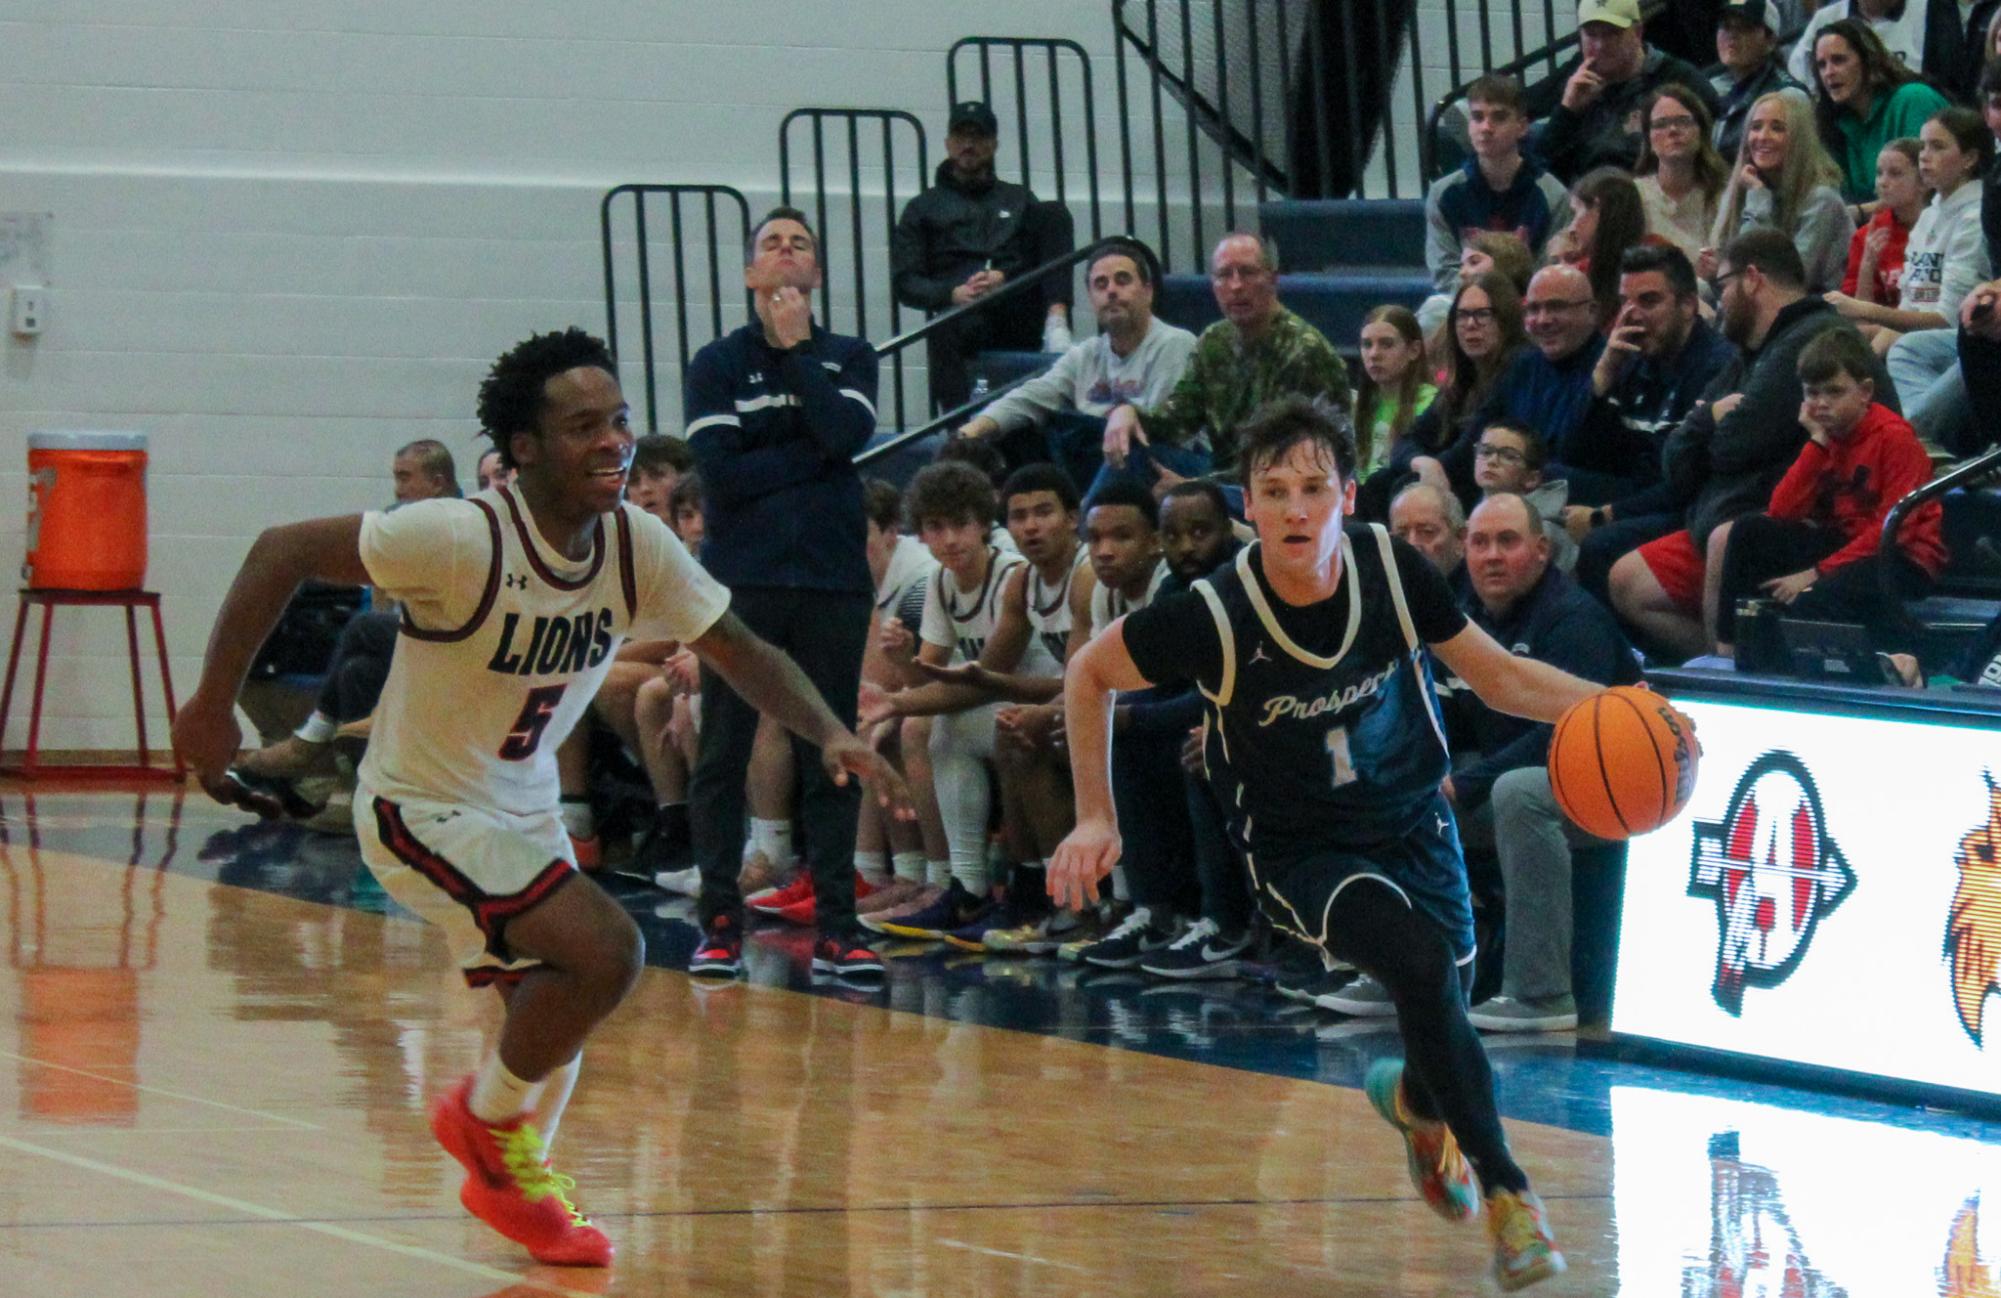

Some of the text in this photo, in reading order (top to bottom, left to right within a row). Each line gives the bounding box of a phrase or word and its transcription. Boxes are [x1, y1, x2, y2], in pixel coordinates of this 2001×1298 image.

[487, 607, 613, 675] LIONS
[498, 683, 568, 762] 5
[1325, 725, 1358, 789] 1
